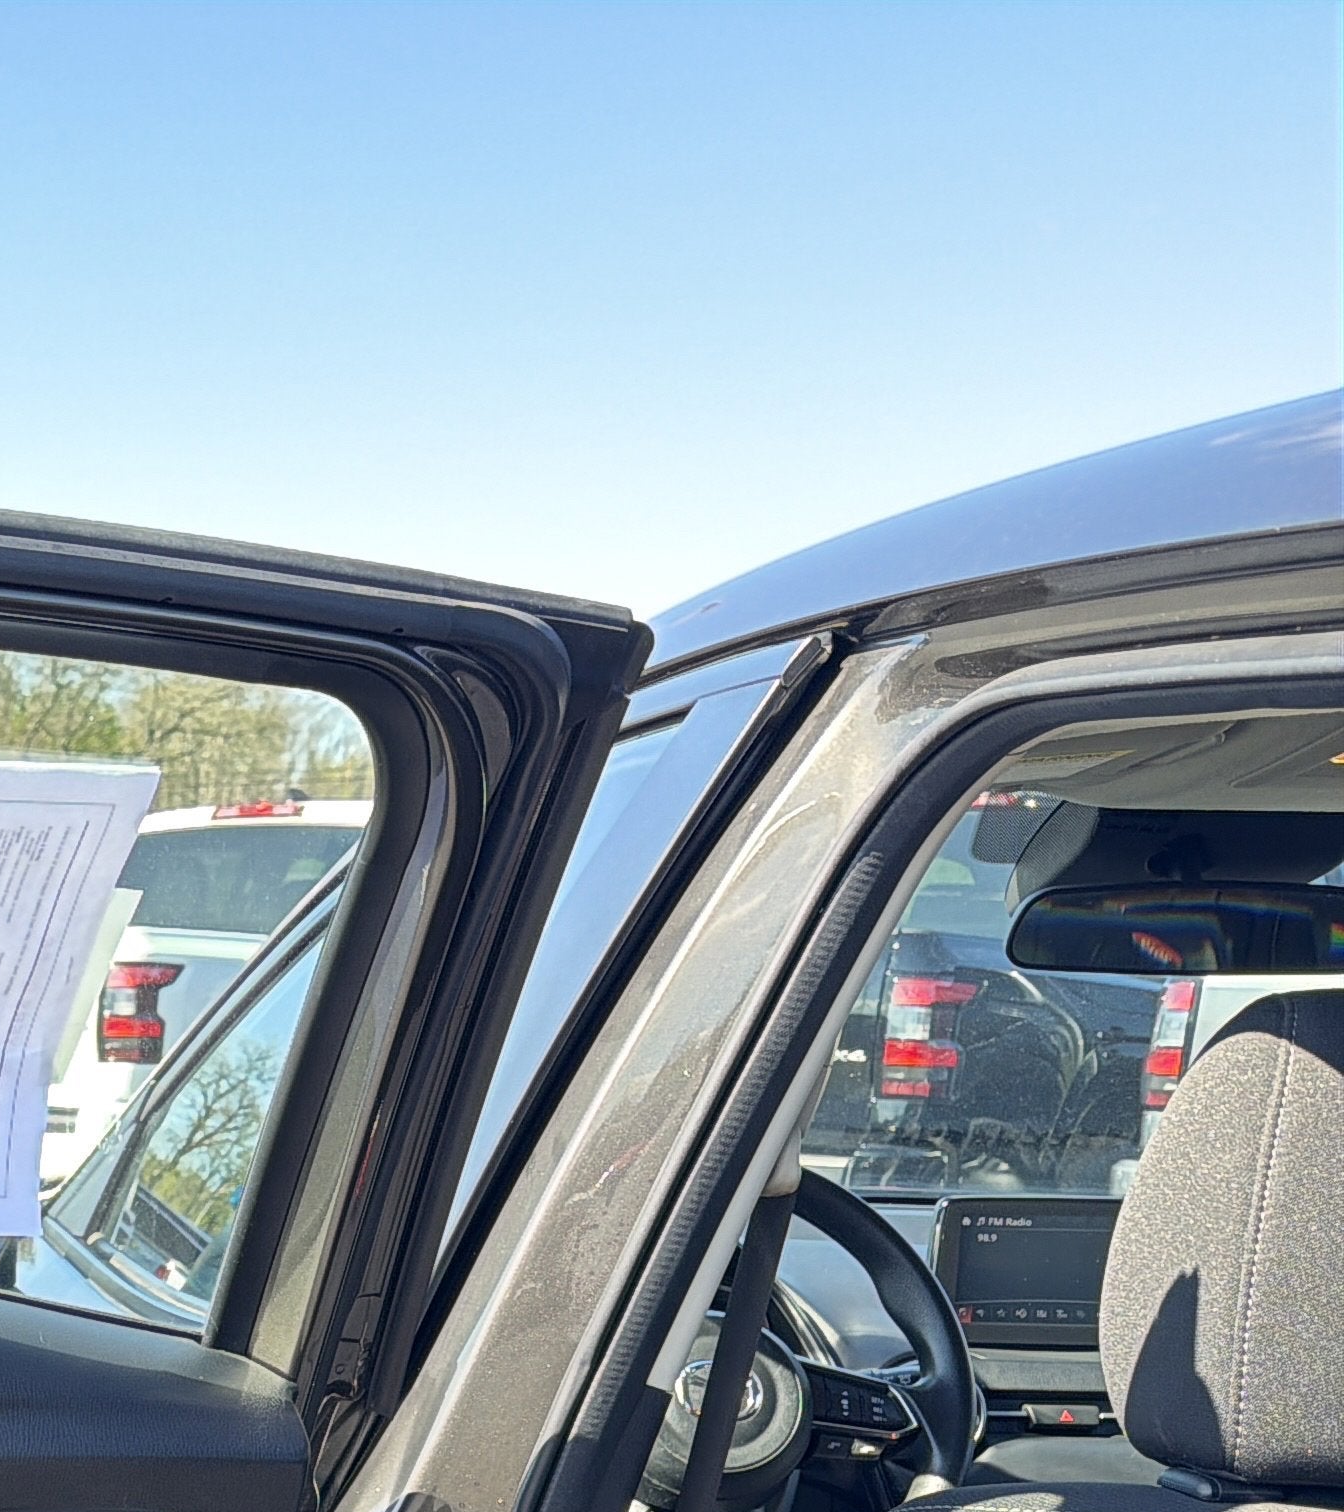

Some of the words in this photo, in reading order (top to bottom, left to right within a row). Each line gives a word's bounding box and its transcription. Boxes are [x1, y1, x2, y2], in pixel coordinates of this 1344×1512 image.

[987, 1217, 1003, 1227] FM
[1005, 1217, 1032, 1227] Radio
[977, 1233, 997, 1242] 98.9
